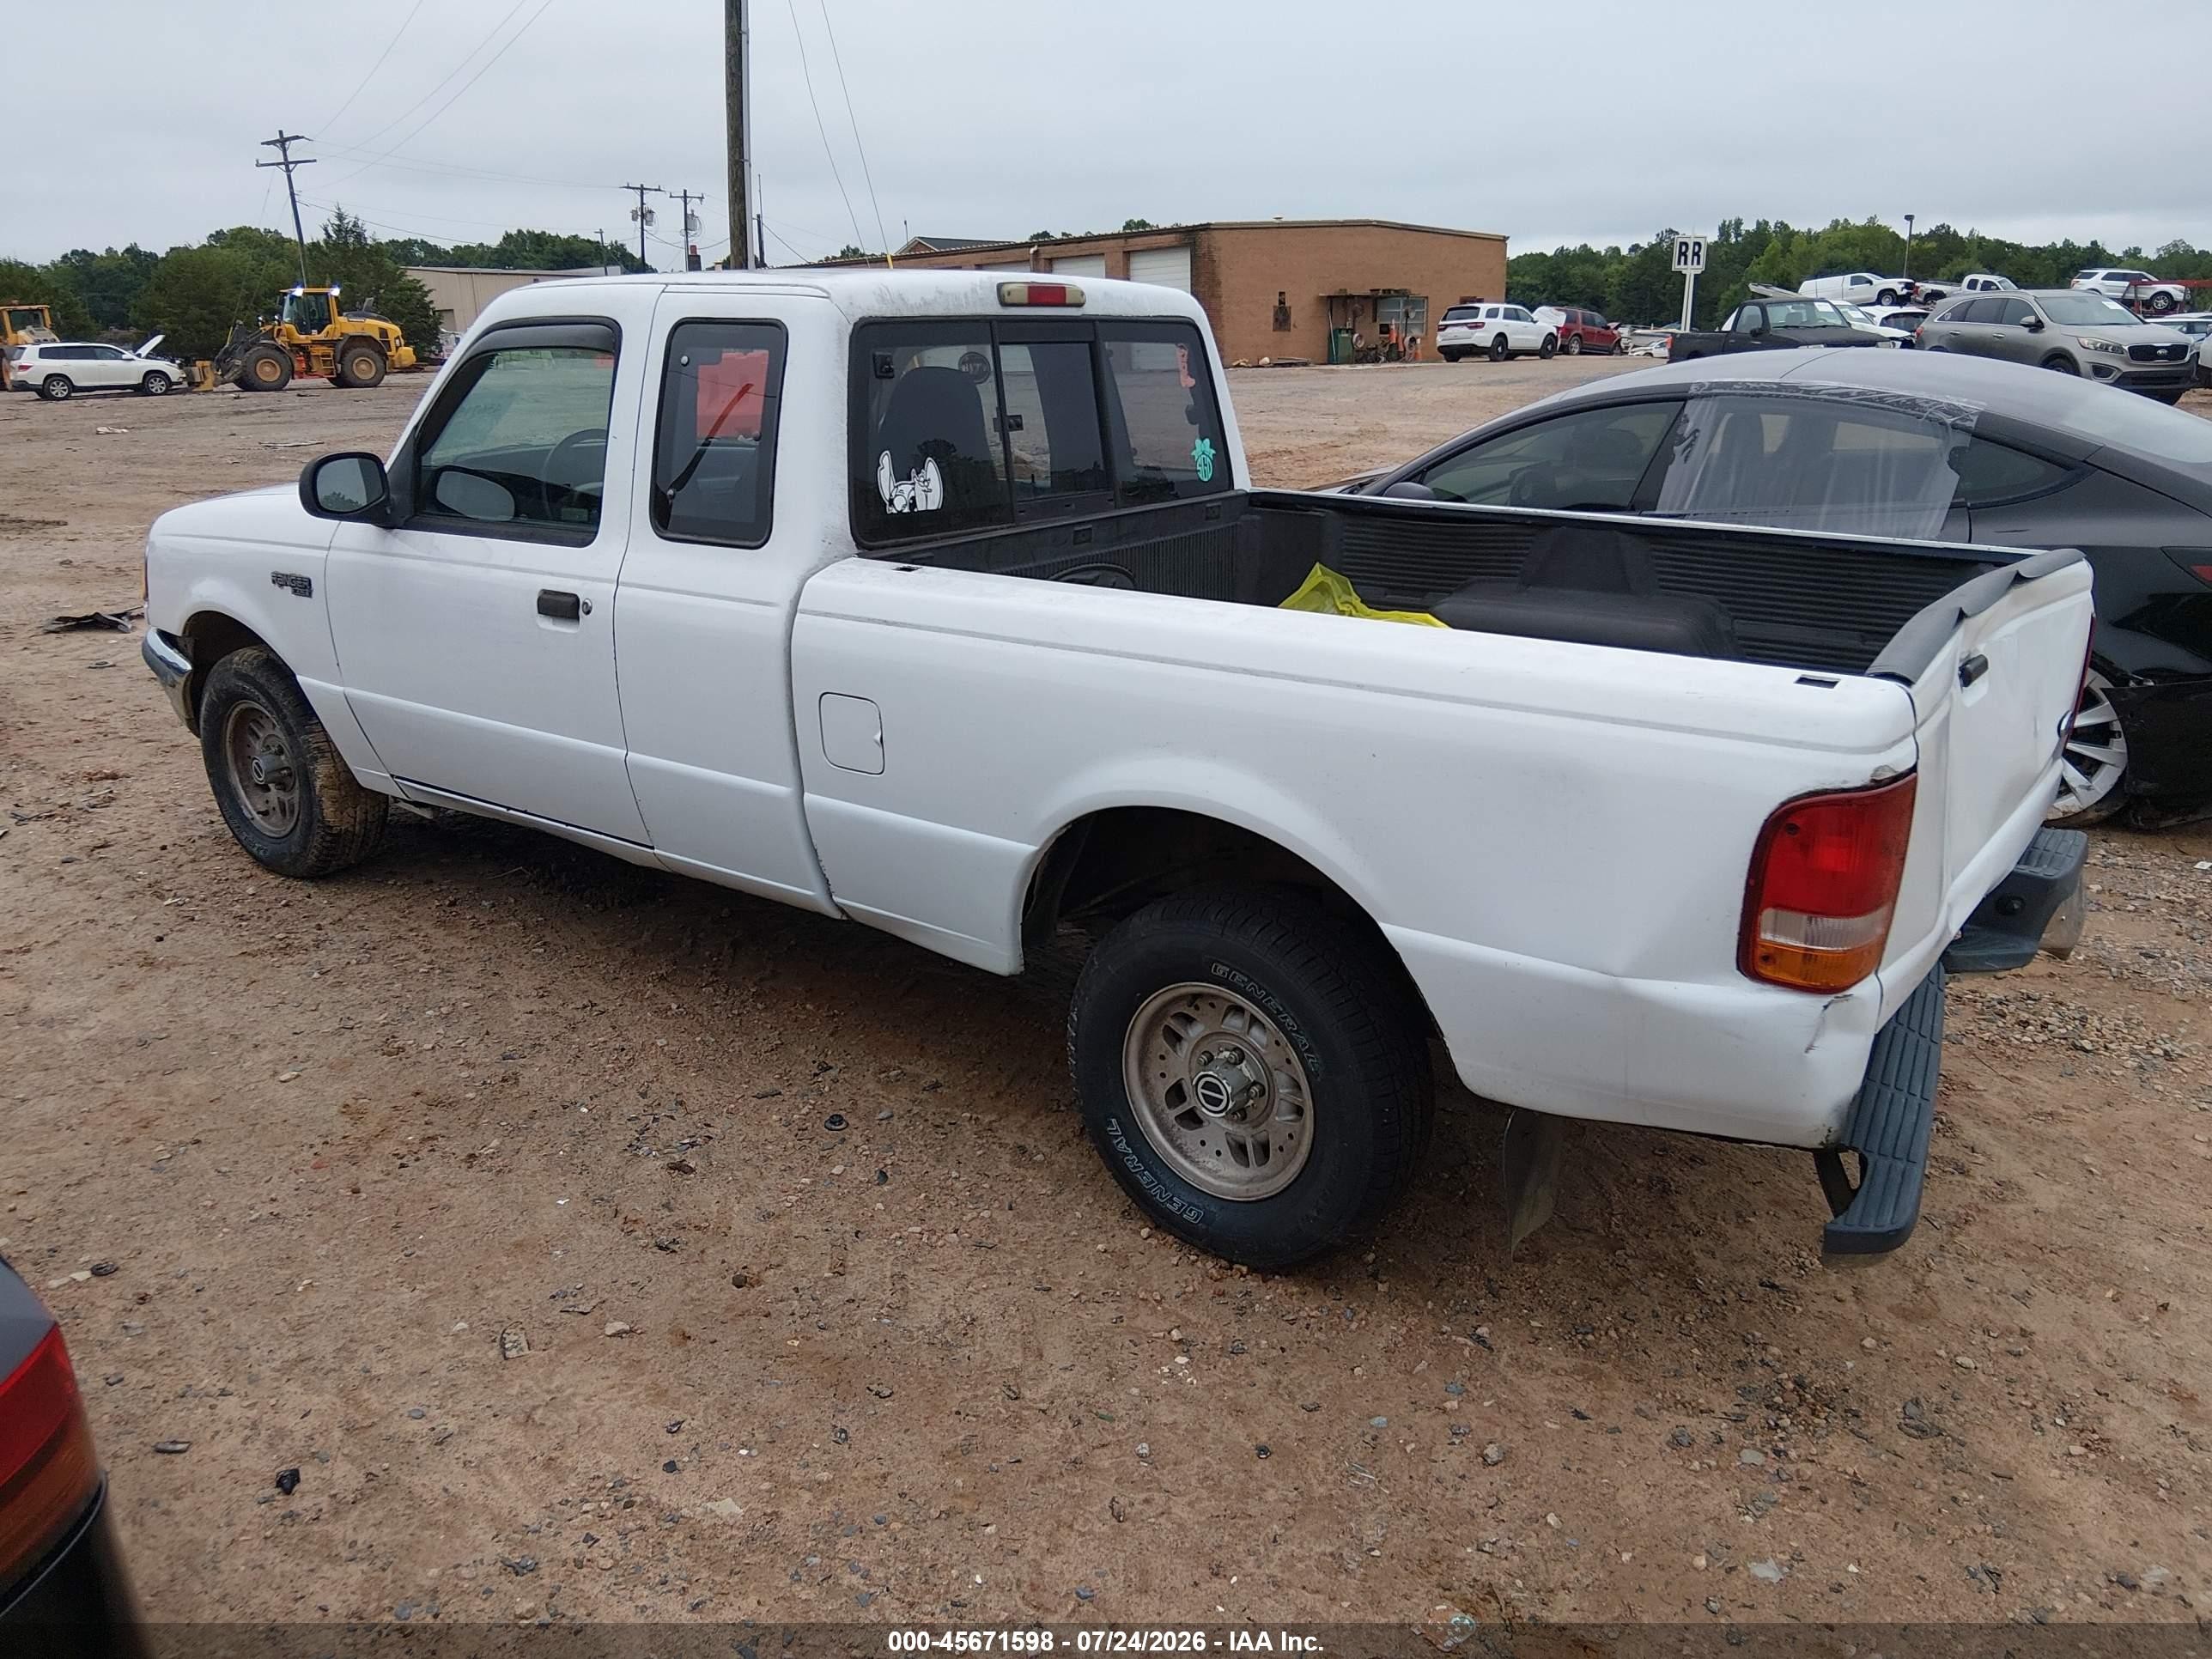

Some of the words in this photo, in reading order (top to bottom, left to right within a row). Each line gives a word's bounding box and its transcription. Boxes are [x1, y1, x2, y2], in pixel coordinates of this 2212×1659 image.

[1676, 240, 1703, 266] RR
[1211, 962, 1320, 1073] GENERAL
[1106, 1117, 1204, 1224] GENERAL
